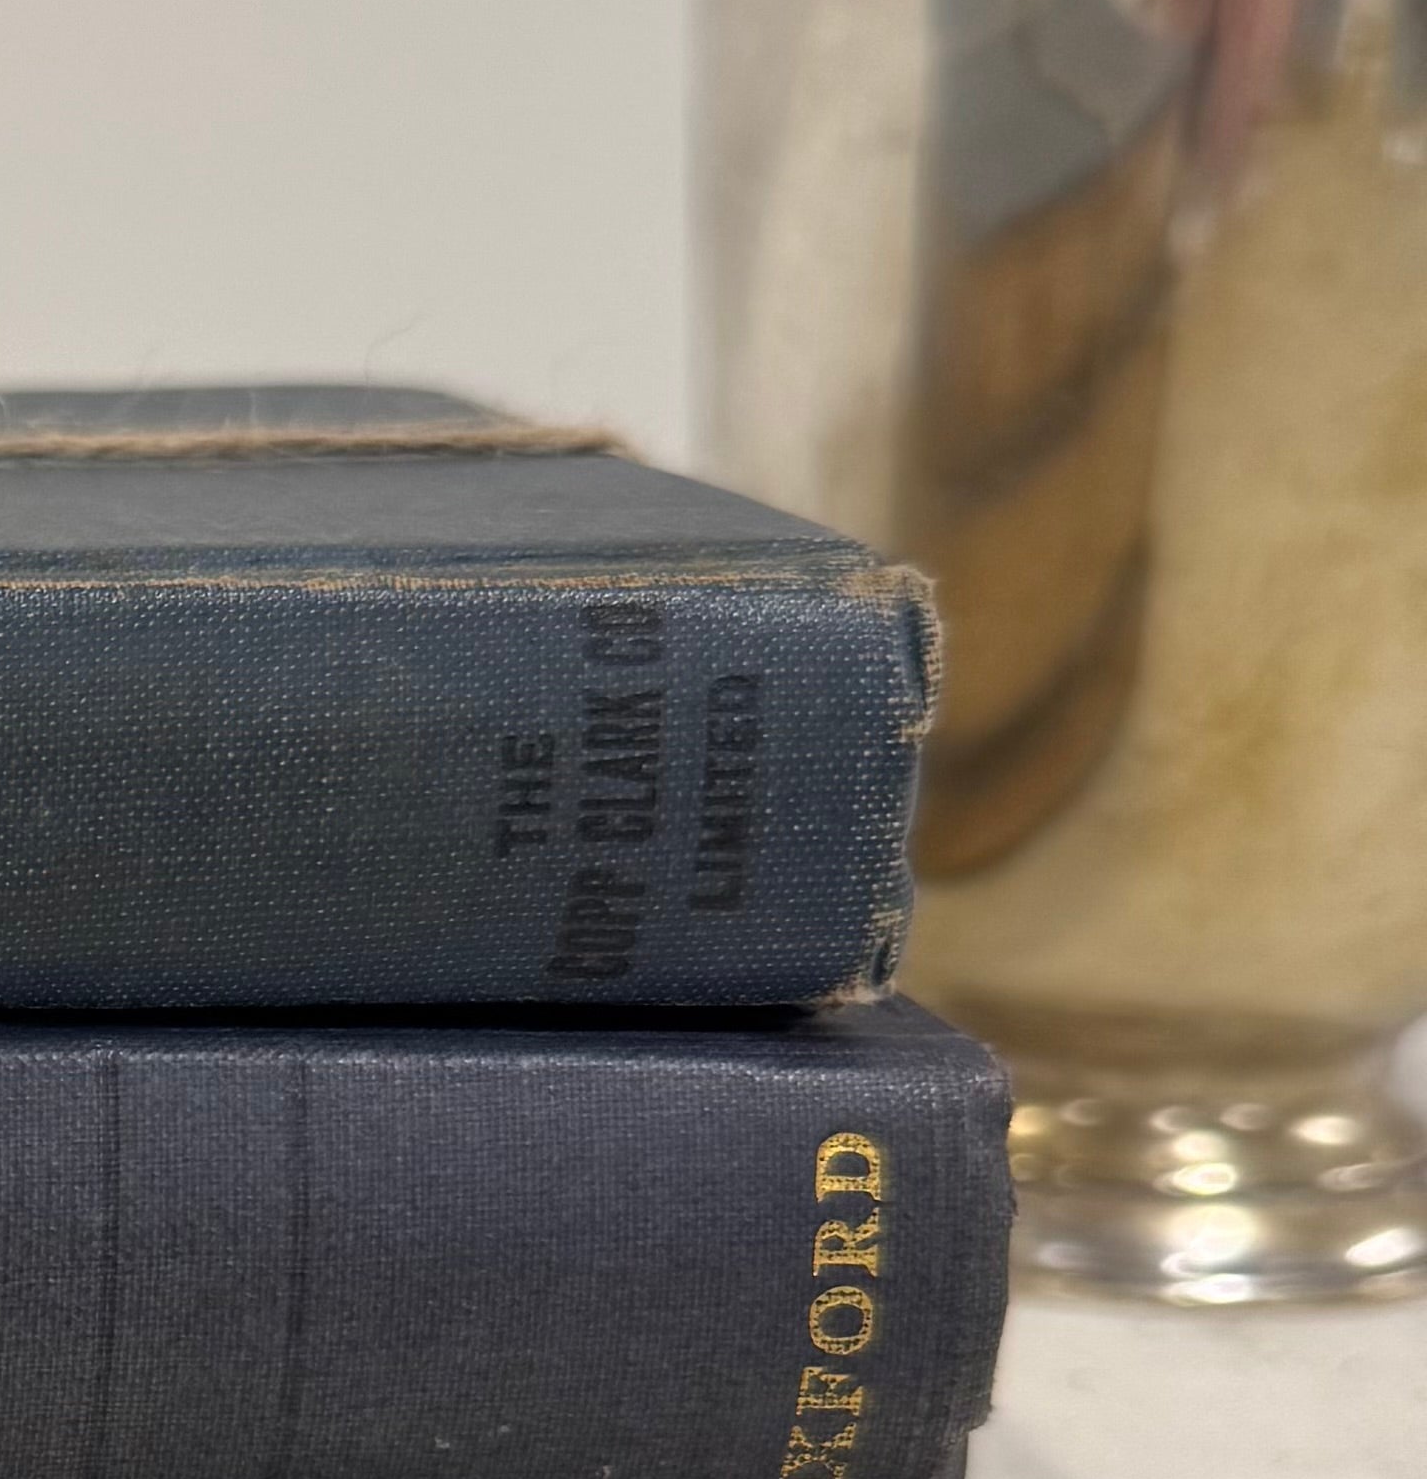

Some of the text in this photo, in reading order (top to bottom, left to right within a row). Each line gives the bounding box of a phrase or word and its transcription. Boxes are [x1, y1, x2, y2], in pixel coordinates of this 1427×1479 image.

[493, 734, 554, 858] THE
[548, 600, 666, 980] COPP CLARK CO
[689, 672, 761, 914] LIMITED
